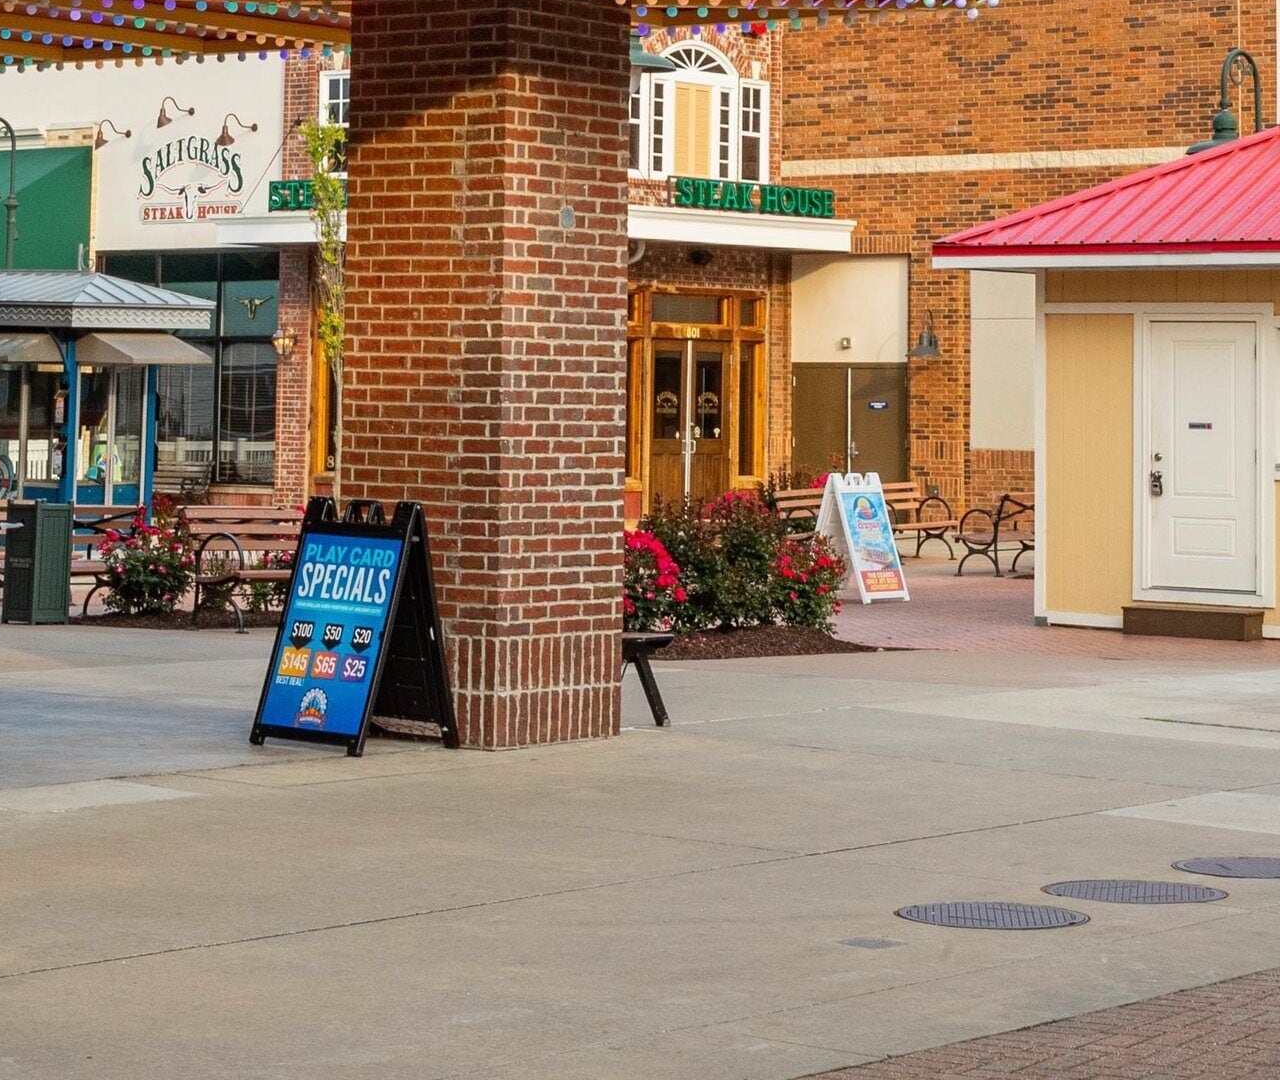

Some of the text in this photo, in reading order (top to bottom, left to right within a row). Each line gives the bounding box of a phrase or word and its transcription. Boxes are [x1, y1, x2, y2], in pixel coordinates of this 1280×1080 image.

[139, 135, 244, 198] SALTGRASS
[679, 177, 835, 217] STEAK HOUSE
[143, 206, 183, 221] STEAK
[305, 544, 395, 568] PLAY CARD
[298, 561, 391, 605] SPECIALS
[292, 622, 372, 644] $100 $50 $20
[282, 652, 366, 678] $145 $65 $25
[275, 675, 290, 685] BEST
